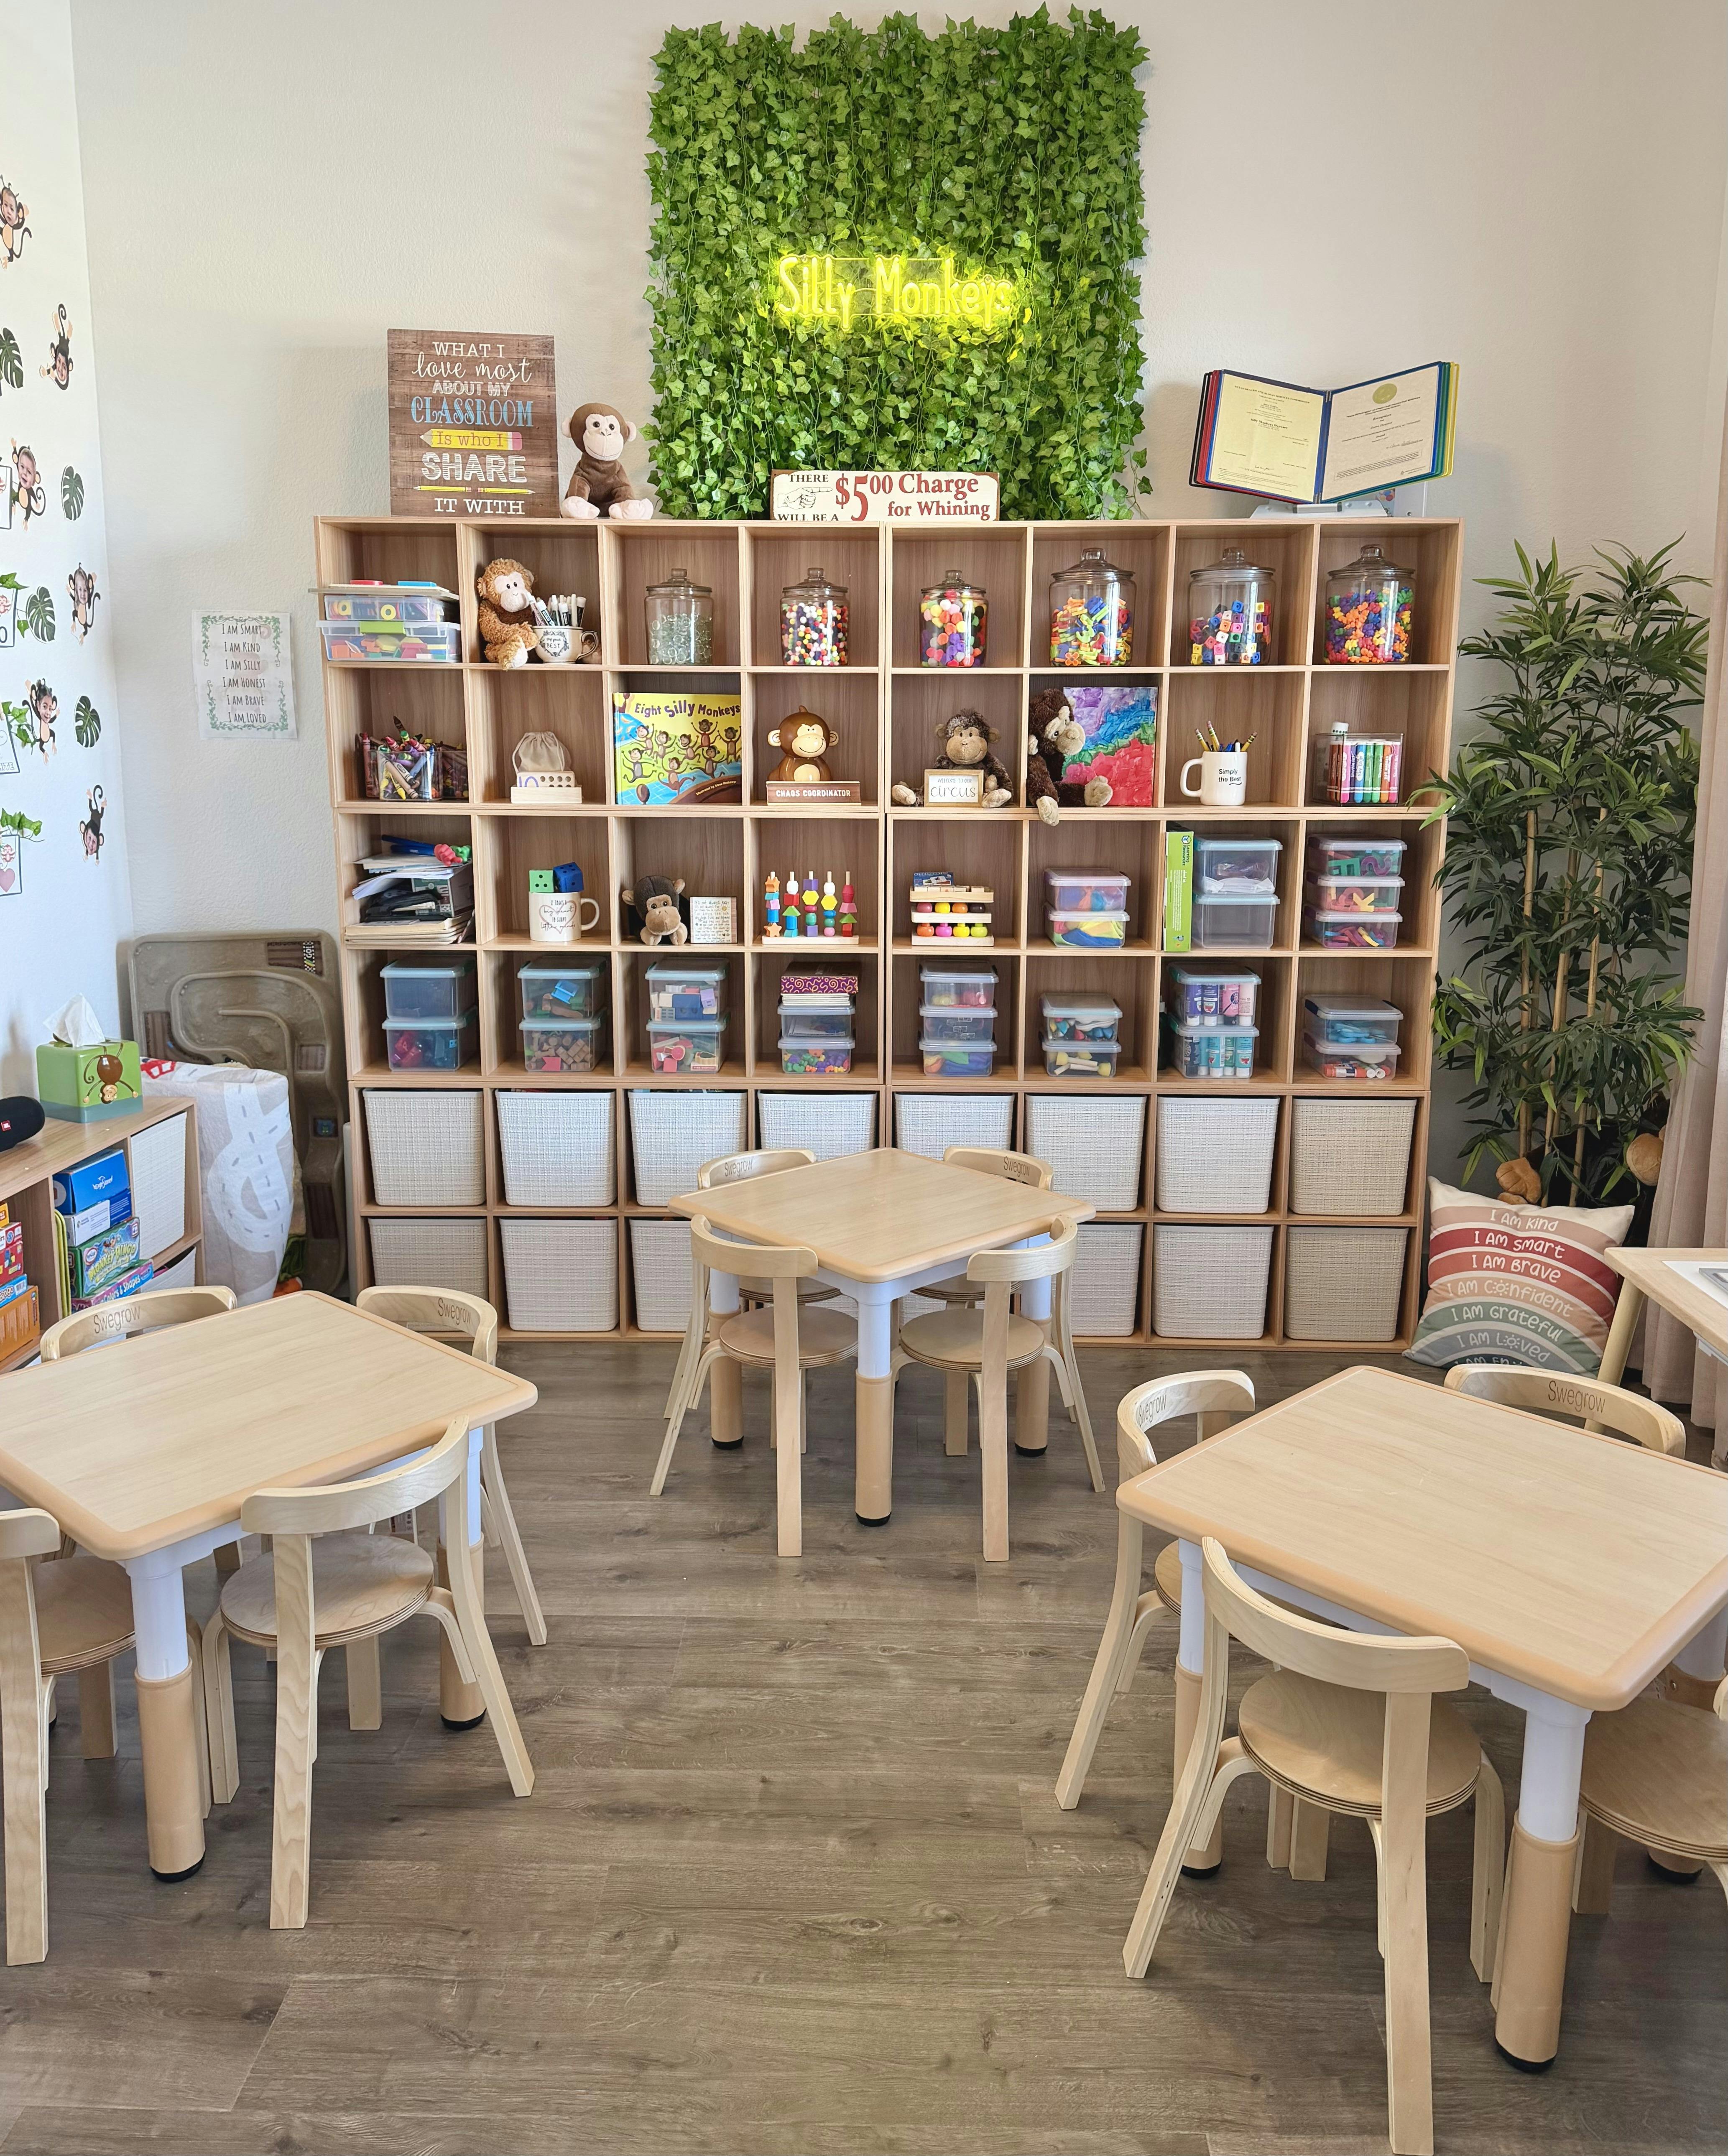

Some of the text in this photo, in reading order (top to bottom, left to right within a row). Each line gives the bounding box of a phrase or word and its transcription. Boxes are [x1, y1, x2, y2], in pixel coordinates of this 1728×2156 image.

[778, 256, 1011, 330] Silly Monkeys
[432, 342, 505, 358] WHAT I
[411, 351, 532, 383] love most
[432, 380, 510, 397] ABOUT MY
[411, 395, 534, 427] CLASSROOM
[436, 431, 504, 447] Is who I
[421, 452, 528, 483] SHARE
[789, 474, 829, 483] THERE
[898, 472, 979, 501] Charge
[434, 498, 525, 515] IT WITH
[888, 501, 990, 521] for Whining
[222, 624, 225, 634] I
[227, 625, 238, 635] AM
[224, 641, 227, 652] I
[230, 642, 240, 652] AM
[225, 659, 228, 670] I
[231, 660, 242, 670] AM
[222, 677, 226, 687] I
[228, 678, 239, 688] AM
[227, 694, 230, 705] I
[232, 696, 243, 705] AM
[635, 699, 740, 718] Eight Silly Monkeys
[228, 712, 232, 723] I
[234, 713, 244, 723] AM
[803, 789, 851, 798] COORDINATOR
[931, 786, 975, 797] circus
[725, 1158, 753, 1176] Swegrow
[1004, 1156, 1030, 1177] Swegrow
[1490, 1209, 1496, 1221] I
[1474, 1230, 1565, 1259] I AM smart
[88, 1250, 116, 1282] MONKEY
[1471, 1254, 1478, 1268] I
[1483, 1255, 1506, 1269] AM
[123, 1274, 141, 1293] Shapes
[1447, 1283, 1454, 1296] I
[1457, 1280, 1478, 1294] AM
[94, 1304, 140, 1334] Swegrow
[437, 1297, 471, 1325] Swegrow
[1451, 1308, 1459, 1321] I
[1463, 1304, 1483, 1319] AM
[1456, 1335, 1466, 1348] I
[1469, 1330, 1490, 1346] AM
[1548, 1380, 1605, 1414] Swegrow
[1138, 1394, 1167, 1427] Swegrow
